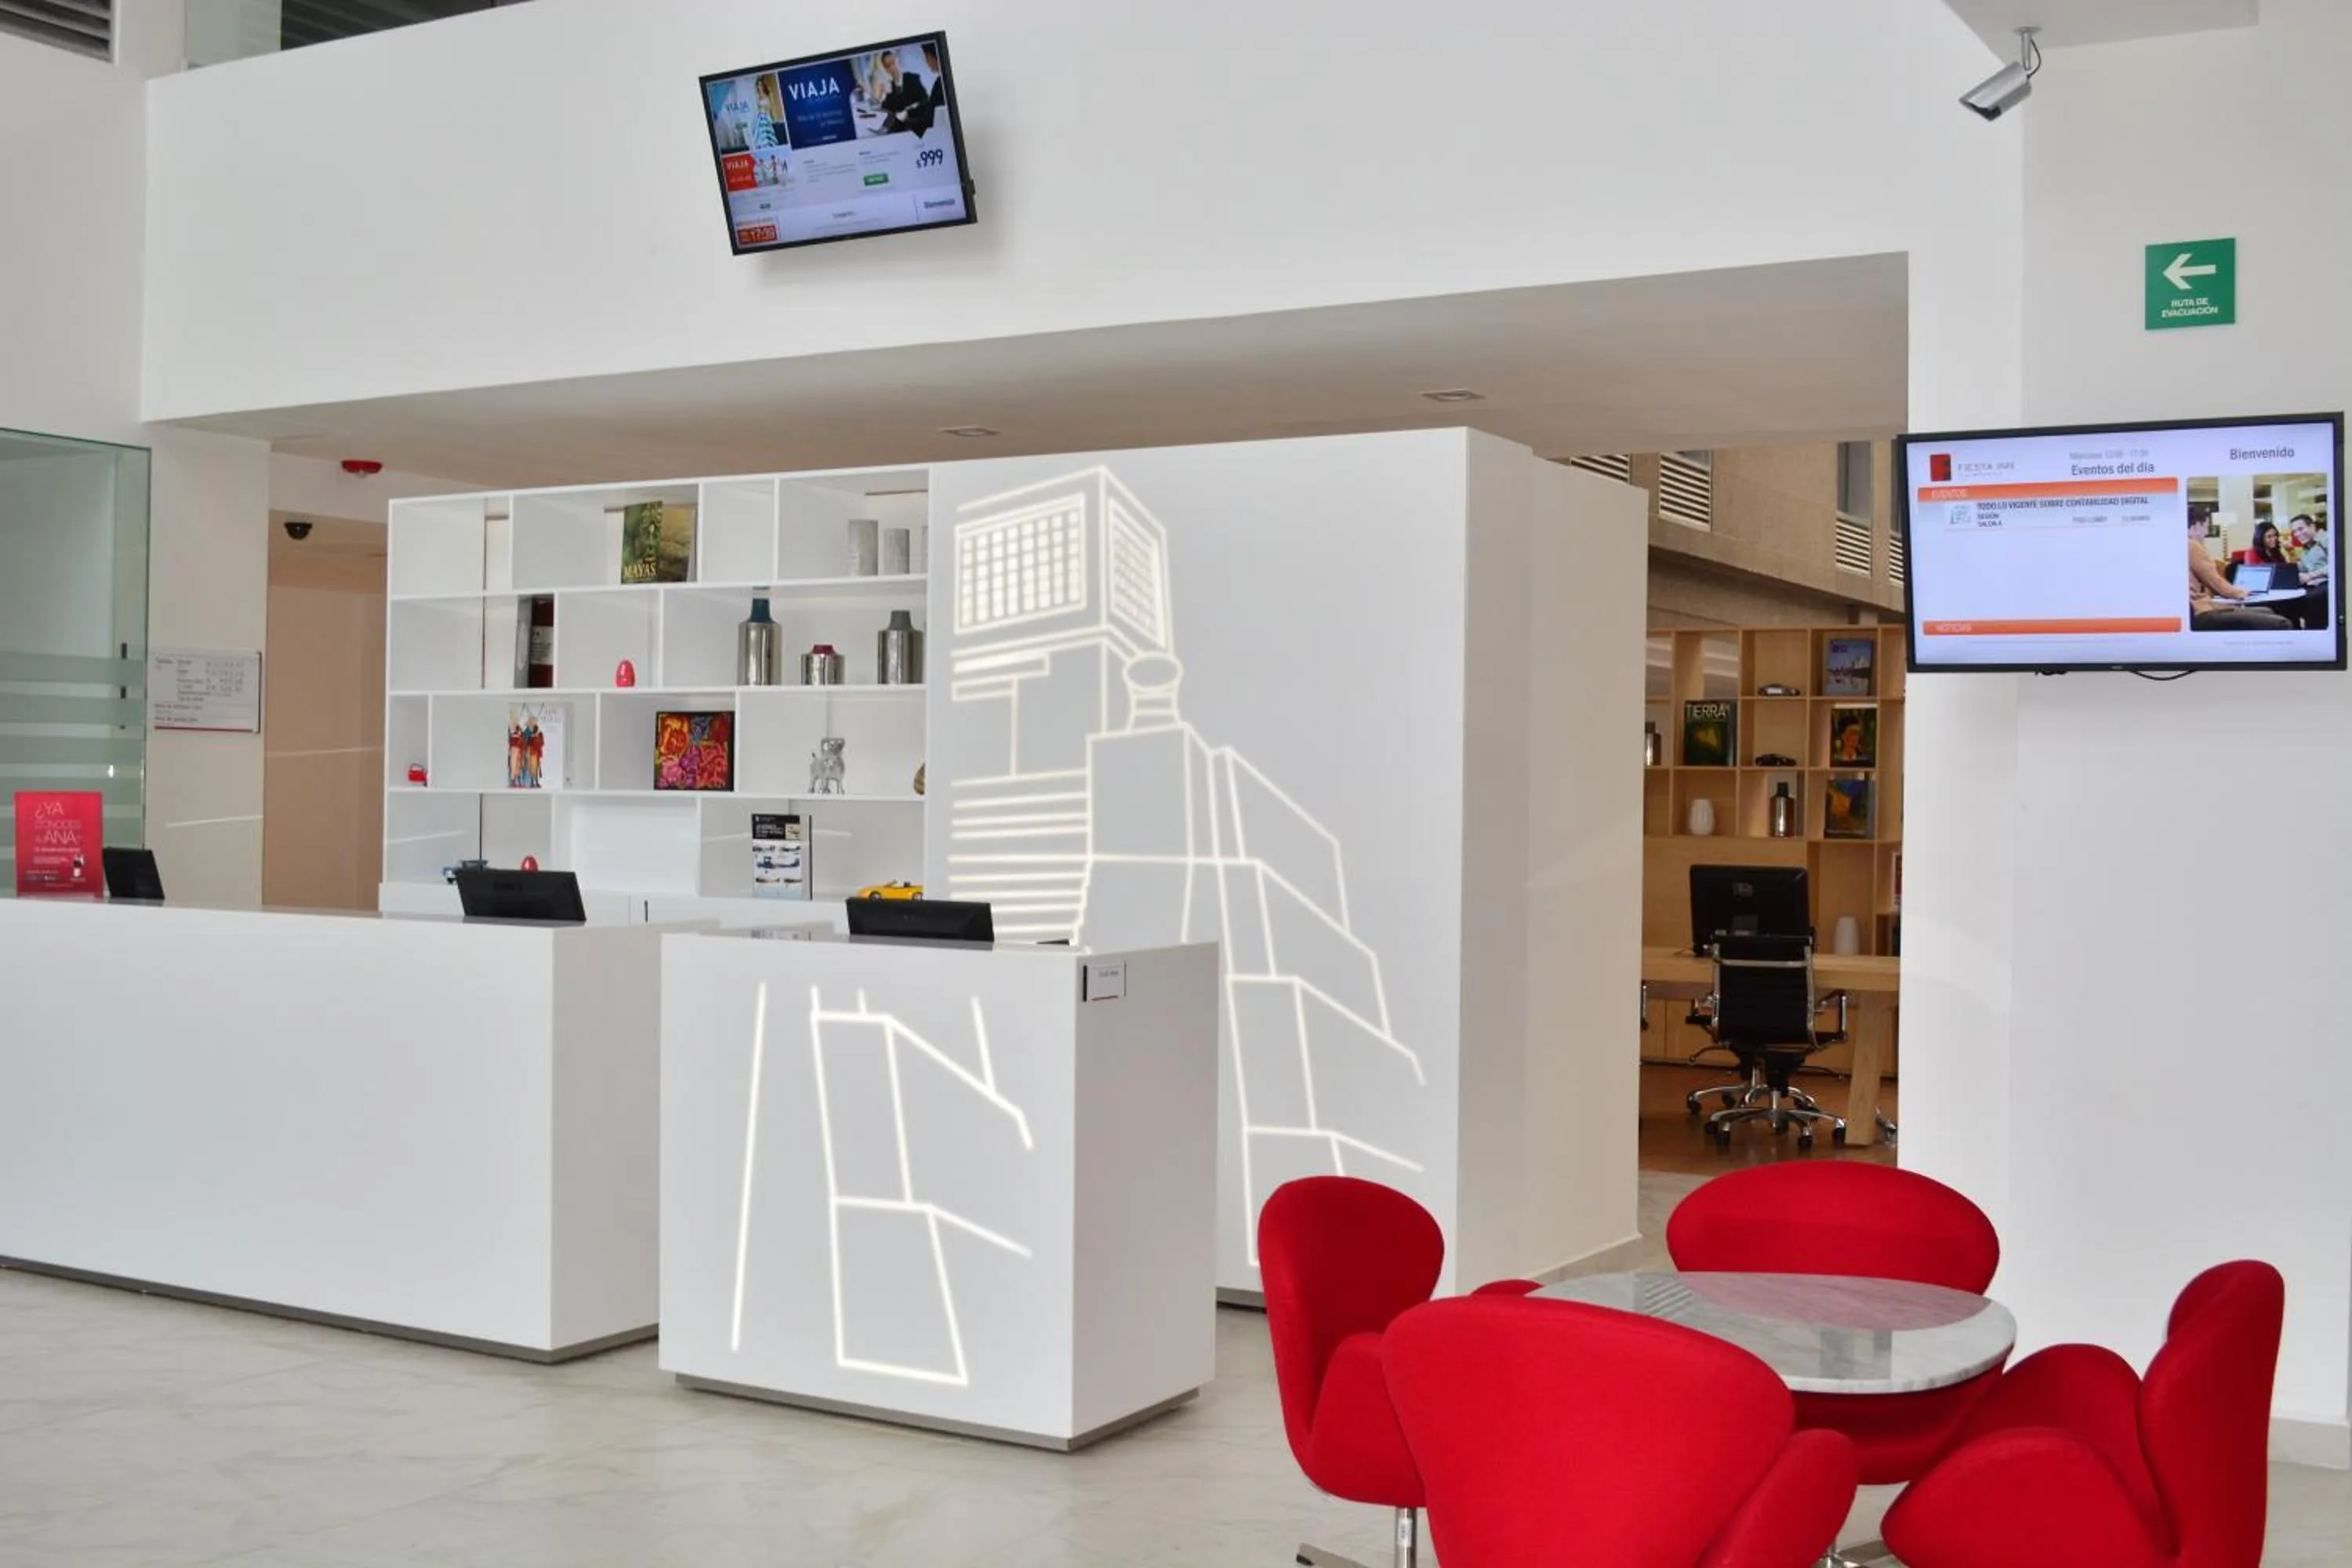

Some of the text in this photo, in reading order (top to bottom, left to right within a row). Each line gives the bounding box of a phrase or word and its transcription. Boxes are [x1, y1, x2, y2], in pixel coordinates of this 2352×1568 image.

[788, 77, 840, 100] VIAJA
[916, 149, 943, 169] $999
[2171, 299, 2194, 307] RUTA
[2161, 305, 2219, 318] EVACUACIÓN
[2229, 446, 2296, 460] Bienvenido
[2071, 464, 2114, 476] Eventos
[2117, 463, 2134, 474] del
[2009, 500, 2037, 510] VIGENTE
[2039, 499, 2063, 508] SOBRE
[2066, 496, 2119, 507] CONTABILIDAD
[2121, 495, 2150, 505] DIGITAL
[623, 563, 656, 578] MAYAS
[35, 801, 64, 819] ¿YA
